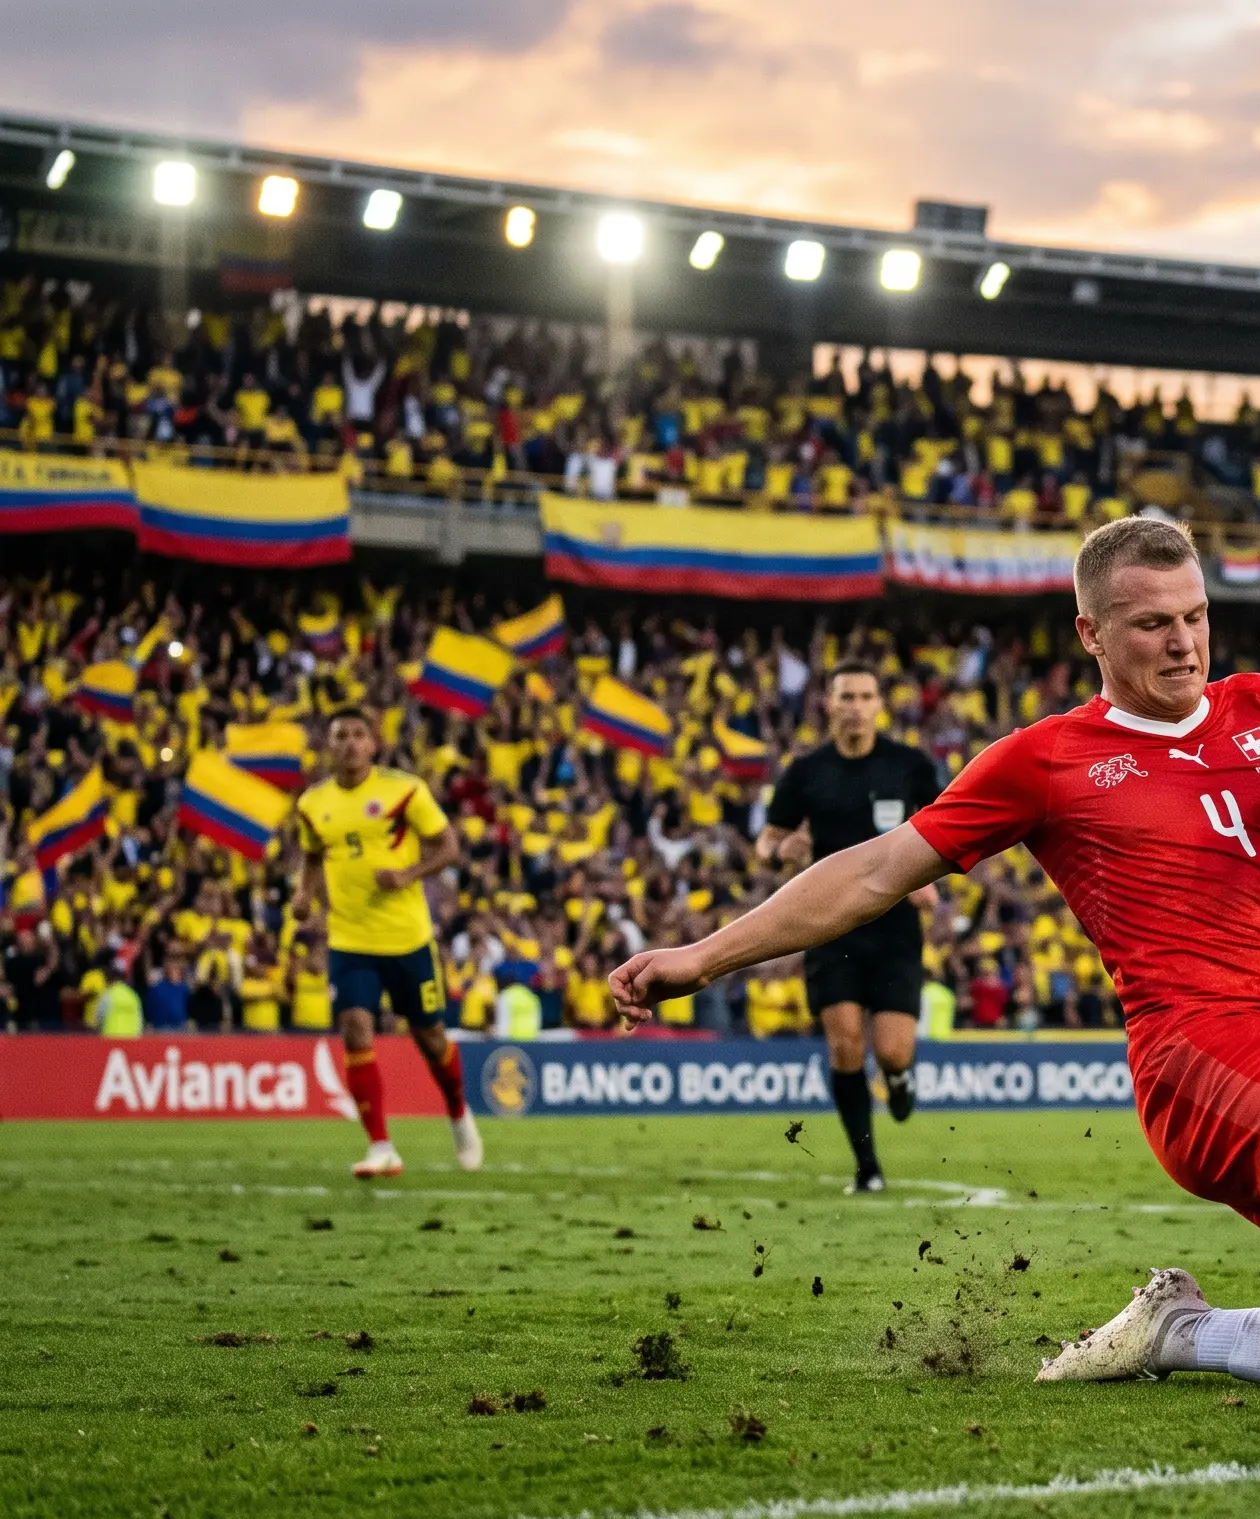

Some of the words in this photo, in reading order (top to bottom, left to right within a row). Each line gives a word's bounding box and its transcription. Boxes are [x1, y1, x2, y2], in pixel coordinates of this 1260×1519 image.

[1200, 790, 1256, 856] 4
[97, 1047, 306, 1110] Avianca
[541, 1062, 673, 1103] BANCO
[679, 1053, 829, 1103] BOGOTÁ
[915, 1061, 1033, 1101] BANCO
[1037, 1061, 1133, 1101] BOGO
